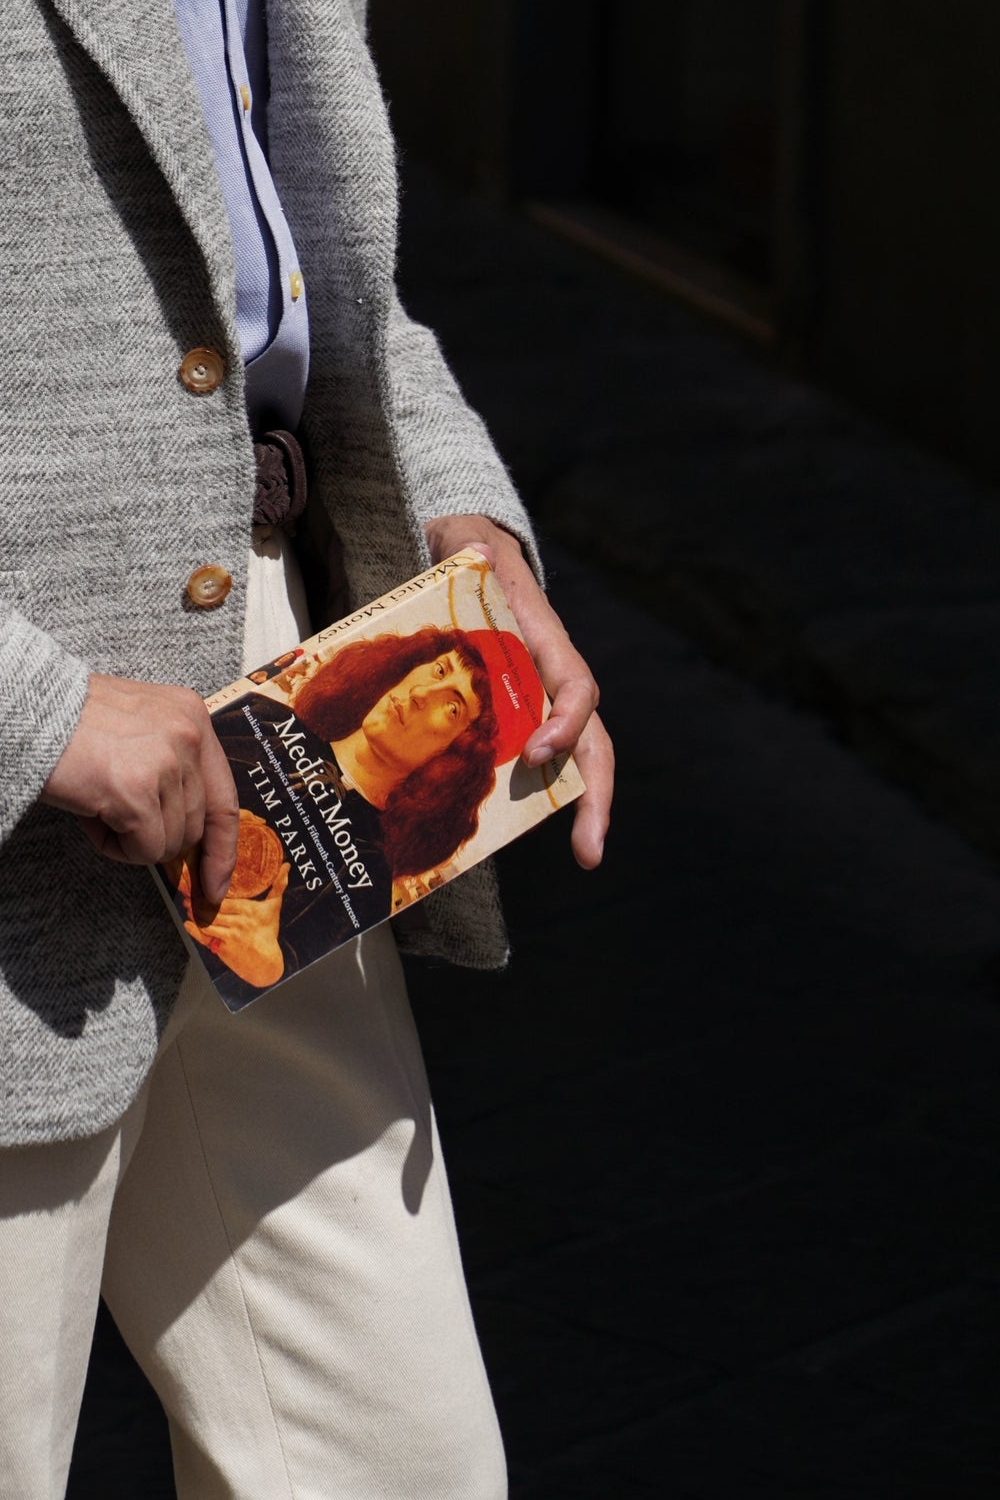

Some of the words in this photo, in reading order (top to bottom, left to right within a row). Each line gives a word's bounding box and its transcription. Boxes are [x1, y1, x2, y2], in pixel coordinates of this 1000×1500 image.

[389, 560, 458, 602] Medici
[317, 602, 386, 644] Money
[482, 602, 500, 636] fabulous
[498, 635, 514, 668] banking
[523, 694, 540, 728] fascinati
[206, 688, 238, 708] TIM
[501, 673, 521, 710] Guardian
[241, 704, 263, 741] Banking,
[261, 739, 290, 787] Metaphysics
[272, 713, 335, 805] Medici
[319, 799, 374, 889] Money
[286, 786, 301, 802] and
[294, 801, 307, 816] Art
[247, 761, 283, 812] TIM
[274, 814, 323, 892] PARKS
[302, 814, 311, 826] in
[306, 824, 344, 895] Fifteenth-Century
[340, 894, 361, 929] Florence
